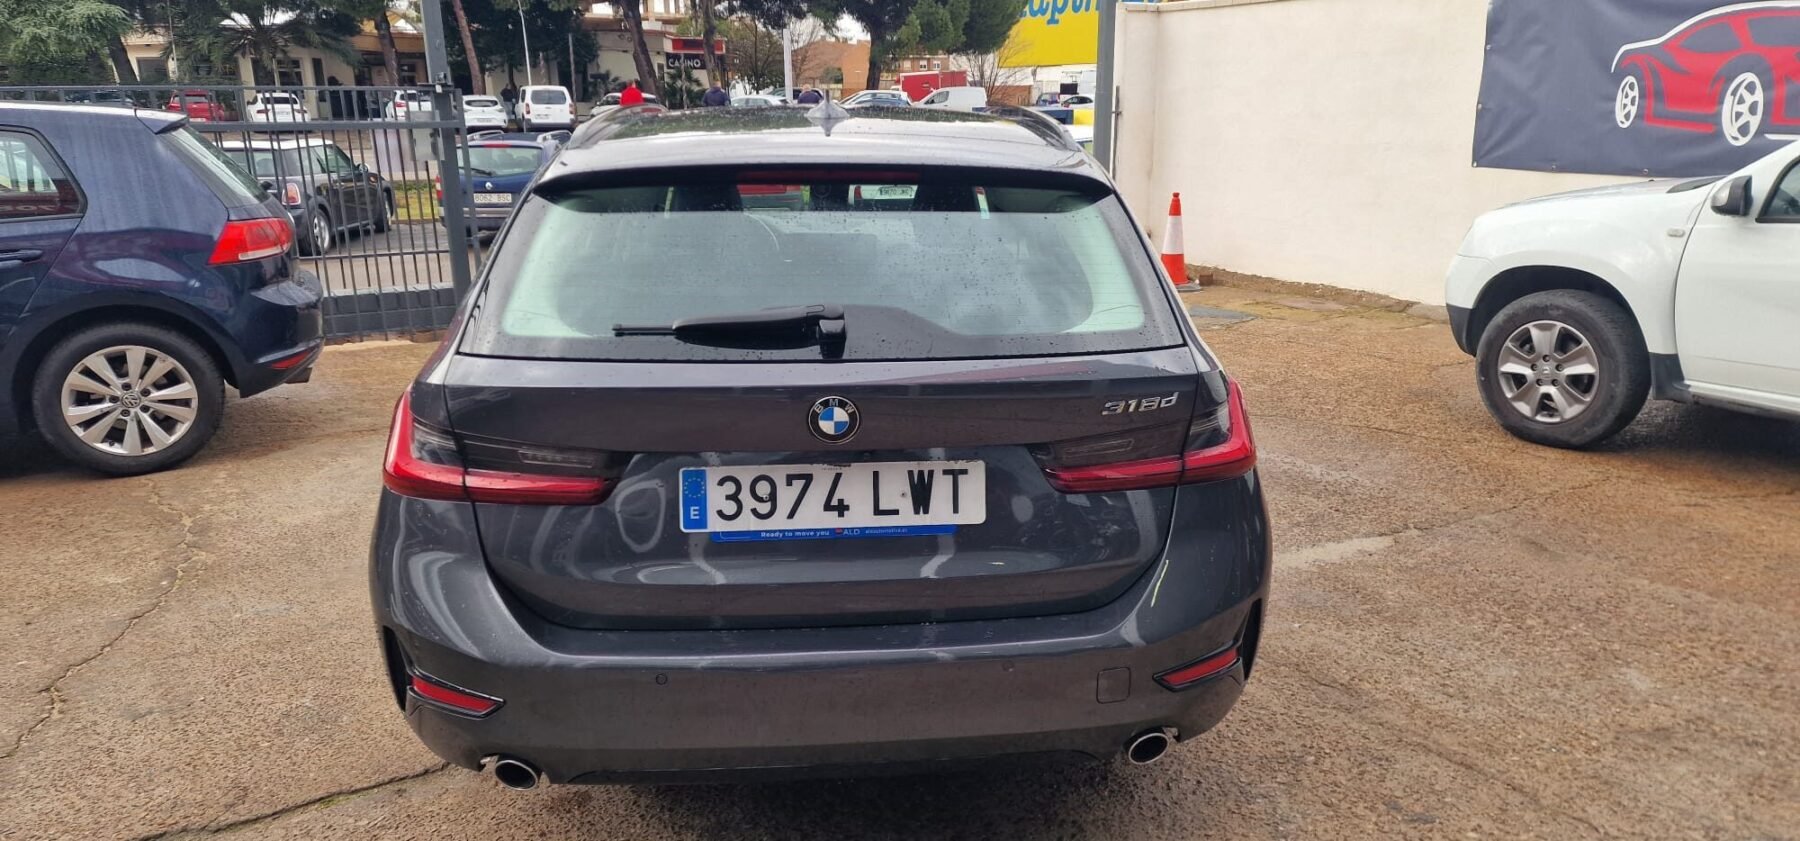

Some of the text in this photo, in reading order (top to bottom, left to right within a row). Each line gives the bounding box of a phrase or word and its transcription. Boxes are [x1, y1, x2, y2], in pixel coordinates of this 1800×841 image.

[814, 398, 855, 414] BMW
[1102, 392, 1179, 415] 318d
[716, 469, 968, 521] 3974 LWT
[690, 506, 700, 520] E
